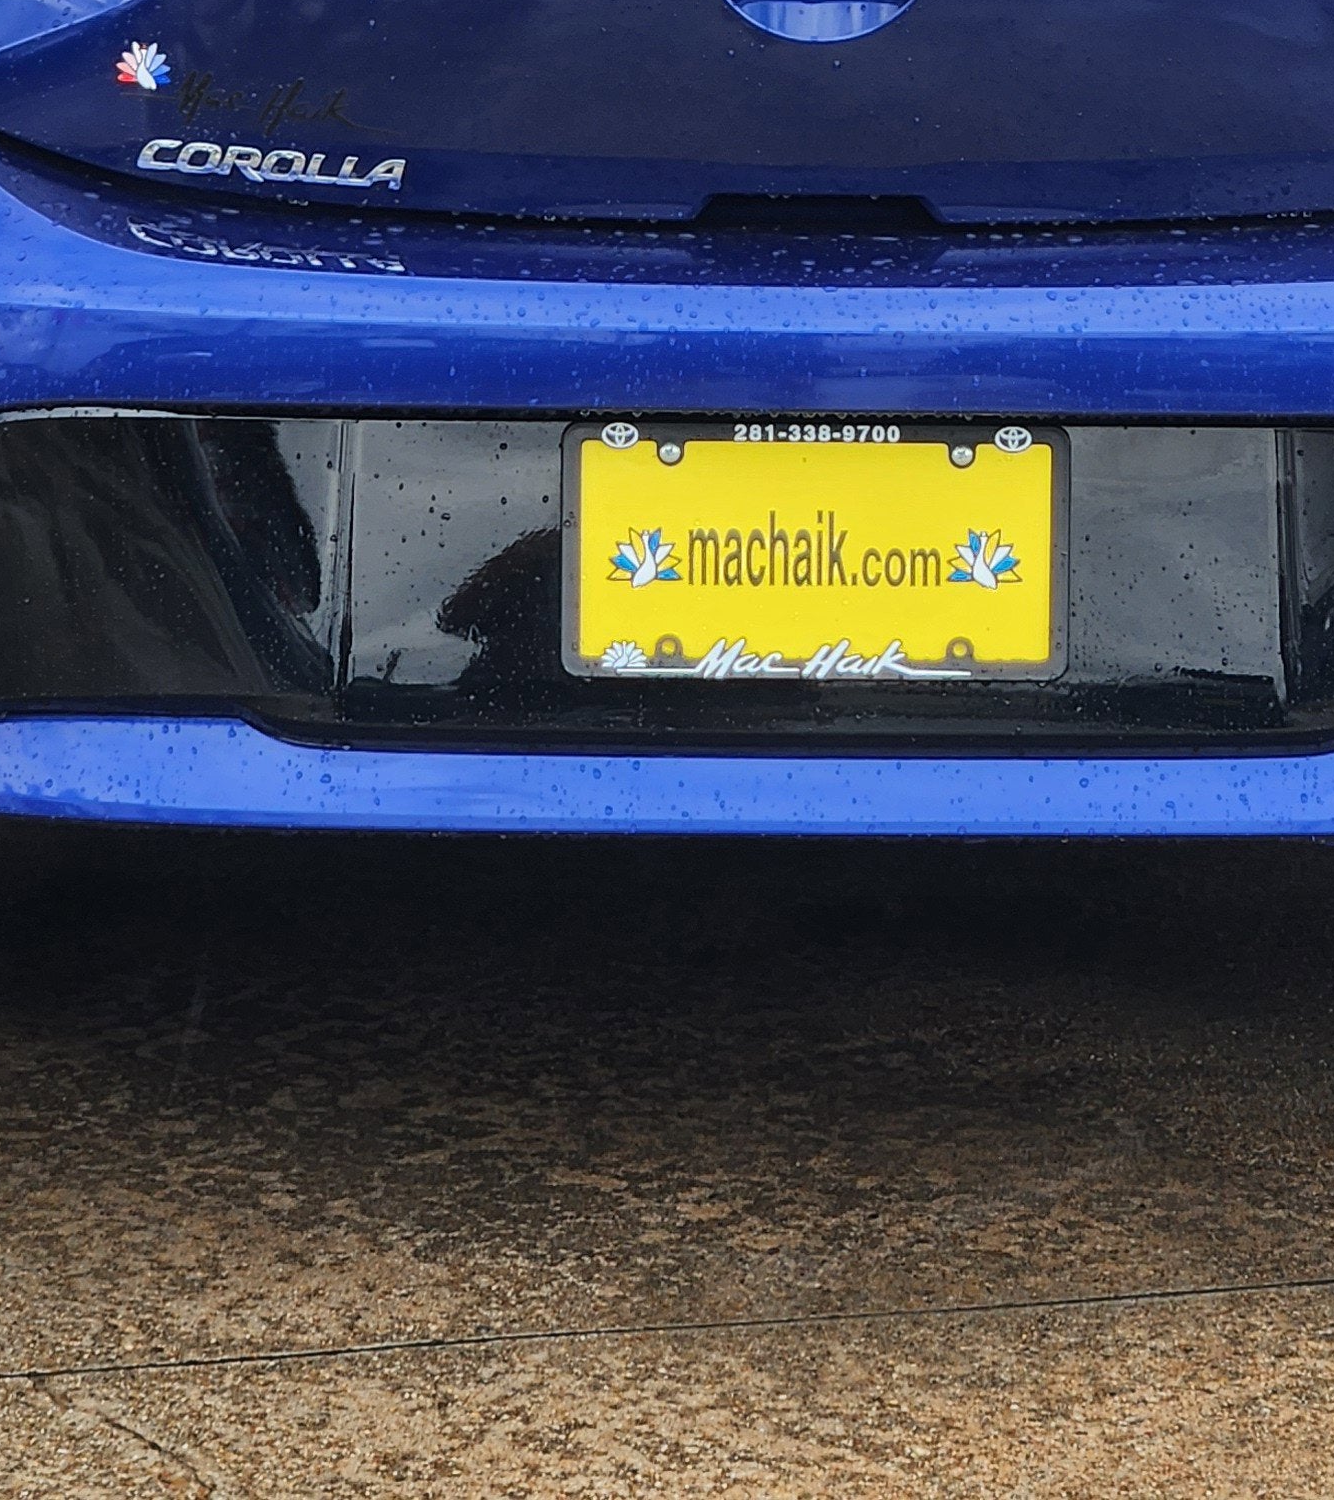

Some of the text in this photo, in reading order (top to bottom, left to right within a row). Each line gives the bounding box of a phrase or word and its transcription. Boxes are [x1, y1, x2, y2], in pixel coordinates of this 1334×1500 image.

[137, 138, 407, 191] COROLLA
[733, 424, 901, 443] 281-338-9700
[688, 509, 942, 587] machaik.com
[694, 637, 798, 679] Mac
